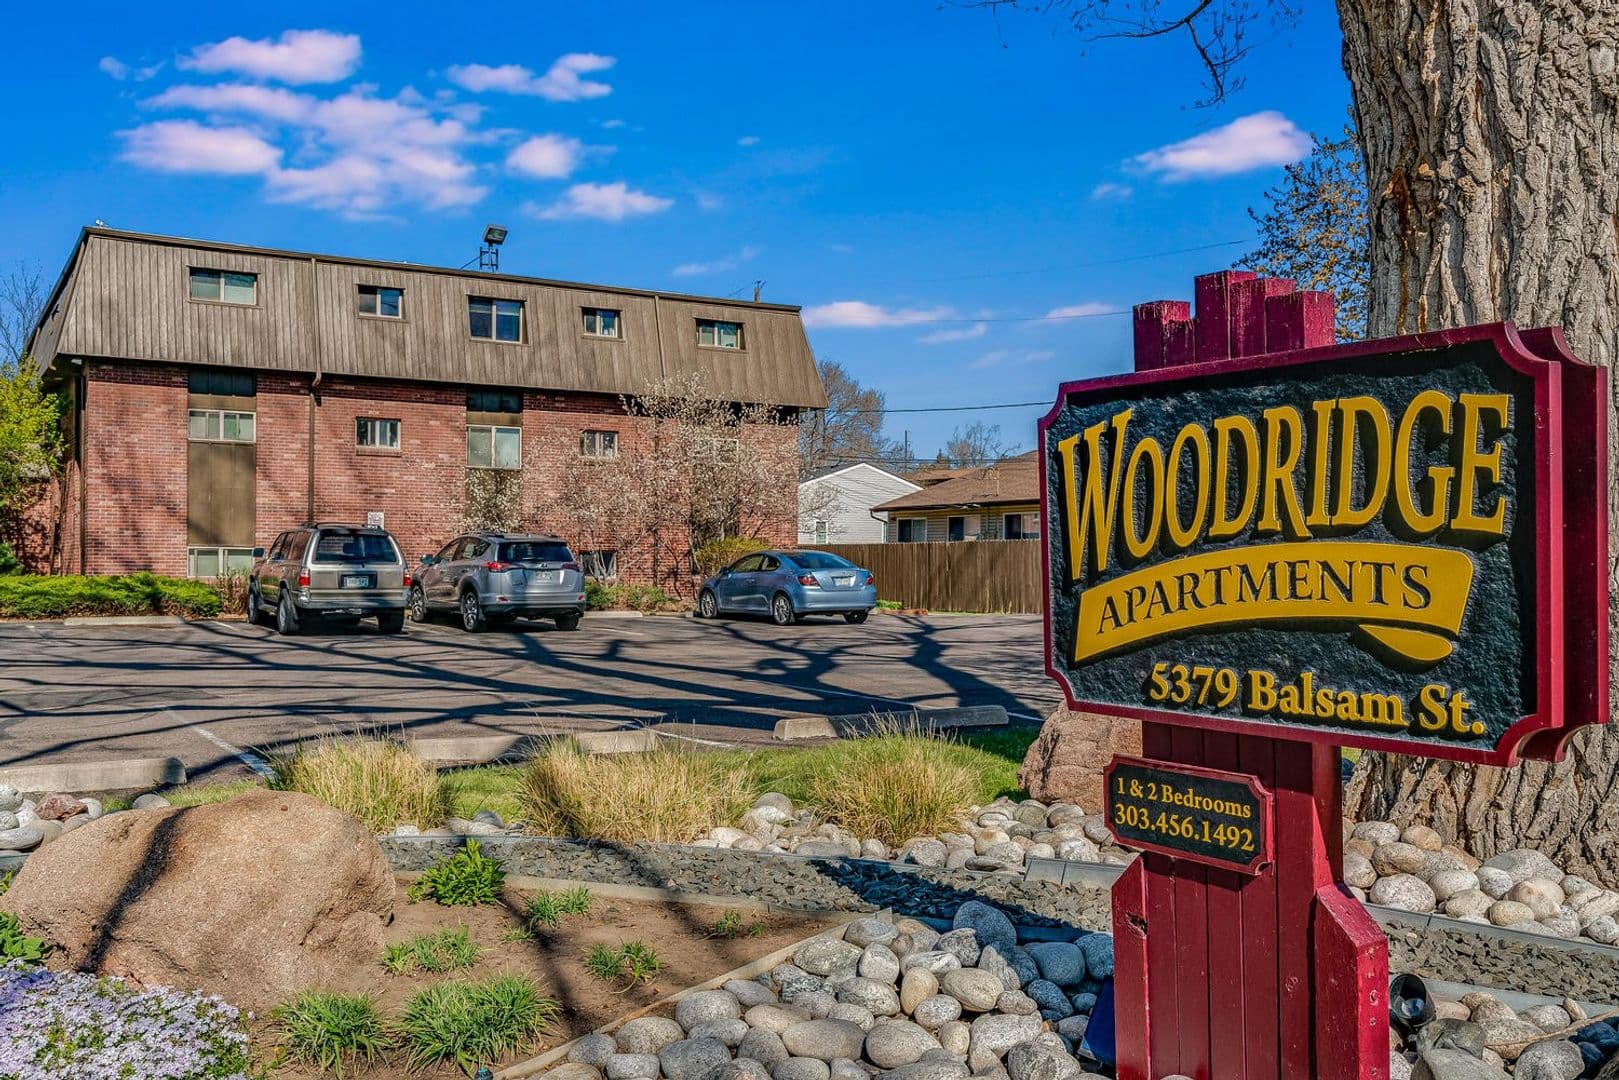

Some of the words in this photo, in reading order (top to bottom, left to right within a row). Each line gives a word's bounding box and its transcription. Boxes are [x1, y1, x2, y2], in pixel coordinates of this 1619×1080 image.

[1058, 391, 1511, 580] WOODRIDGE
[1097, 559, 1432, 634] APARTMENTS
[1149, 663, 1237, 708] 5379
[1248, 671, 1408, 727] Balsam
[1419, 685, 1486, 736] St.
[1115, 803, 1255, 851] 303.456.1492
[1117, 777, 1125, 795] 1
[1129, 779, 1144, 798] &
[1147, 783, 1158, 801] 2
[1161, 784, 1251, 818] Bedrooms
